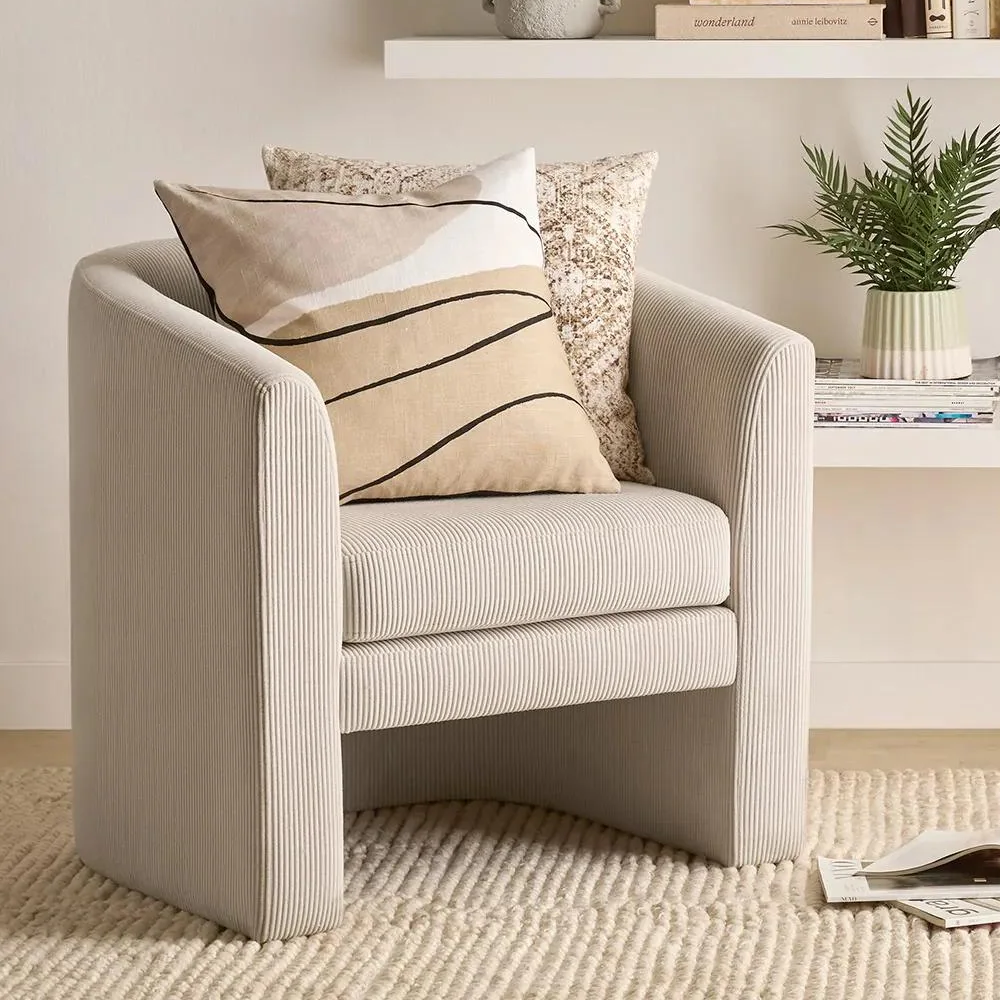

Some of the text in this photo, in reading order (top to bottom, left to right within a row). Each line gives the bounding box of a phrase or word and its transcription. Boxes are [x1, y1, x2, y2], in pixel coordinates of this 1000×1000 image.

[693, 16, 756, 28] wonderland
[791, 16, 848, 27] annie leibovitz
